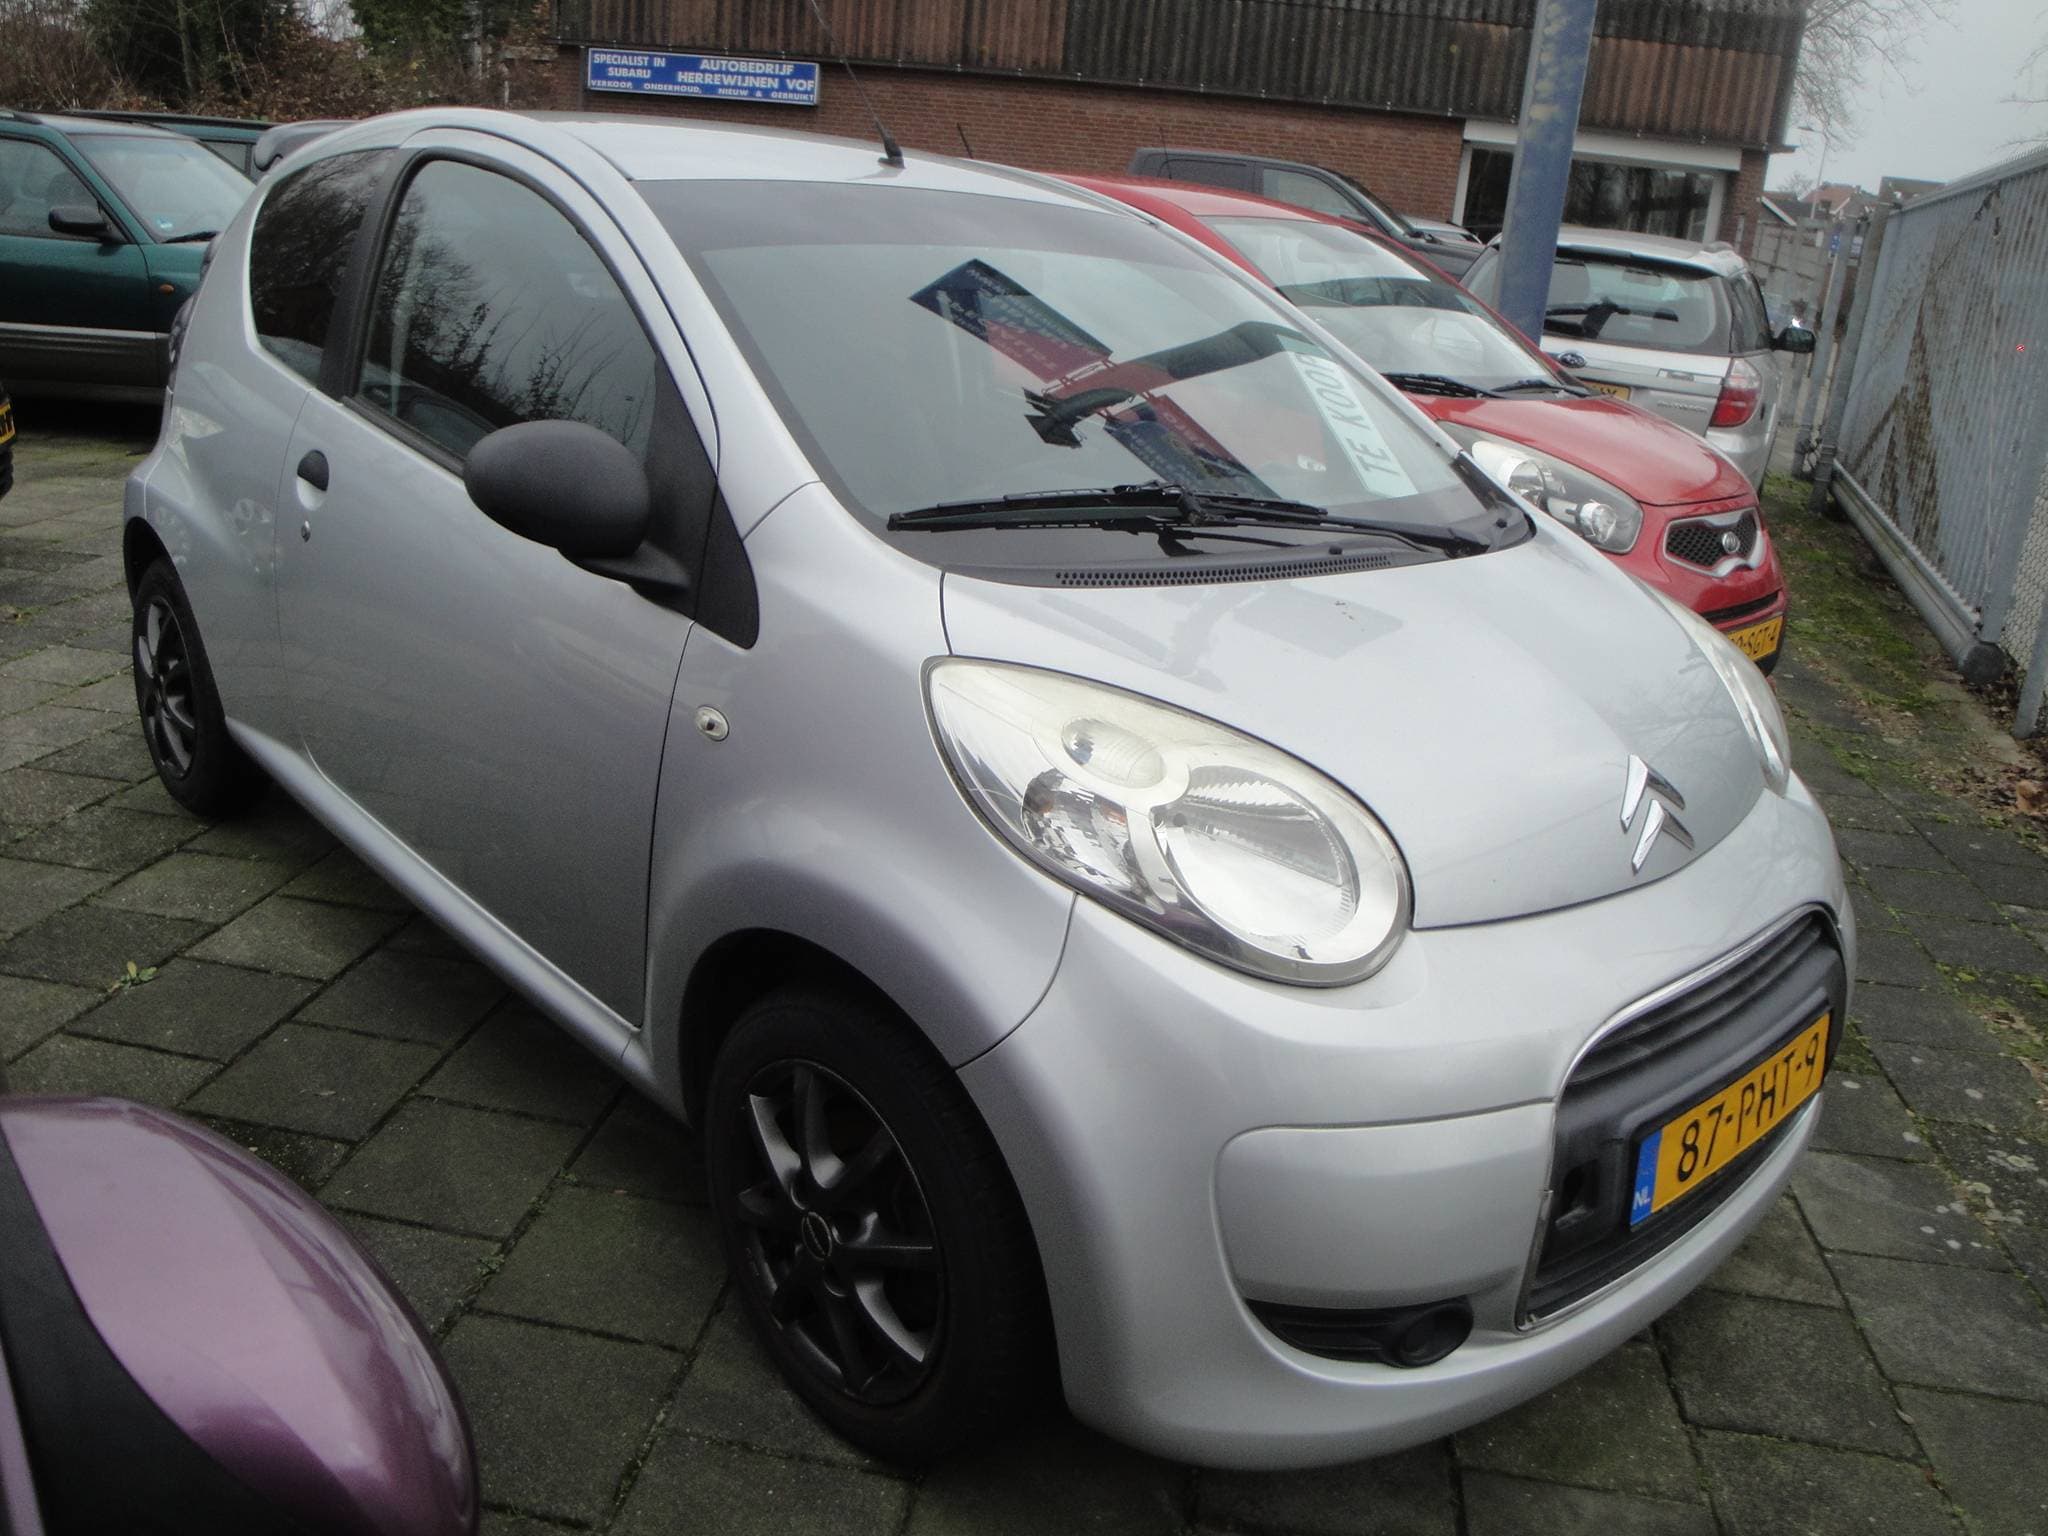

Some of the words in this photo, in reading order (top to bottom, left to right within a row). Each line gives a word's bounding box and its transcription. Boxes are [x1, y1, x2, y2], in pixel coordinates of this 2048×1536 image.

[593, 53, 649, 66] SPECIALIST
[653, 57, 666, 67] IN
[700, 59, 794, 75] AUTOBEDRIJF
[607, 66, 651, 78] SUBARU
[677, 71, 779, 88] HERREWIJNEN
[786, 79, 815, 91] VOF
[718, 87, 749, 97] NIEUW
[1345, 438, 1401, 477] TE
[1677, 1031, 1820, 1183] 87-PHT-9
